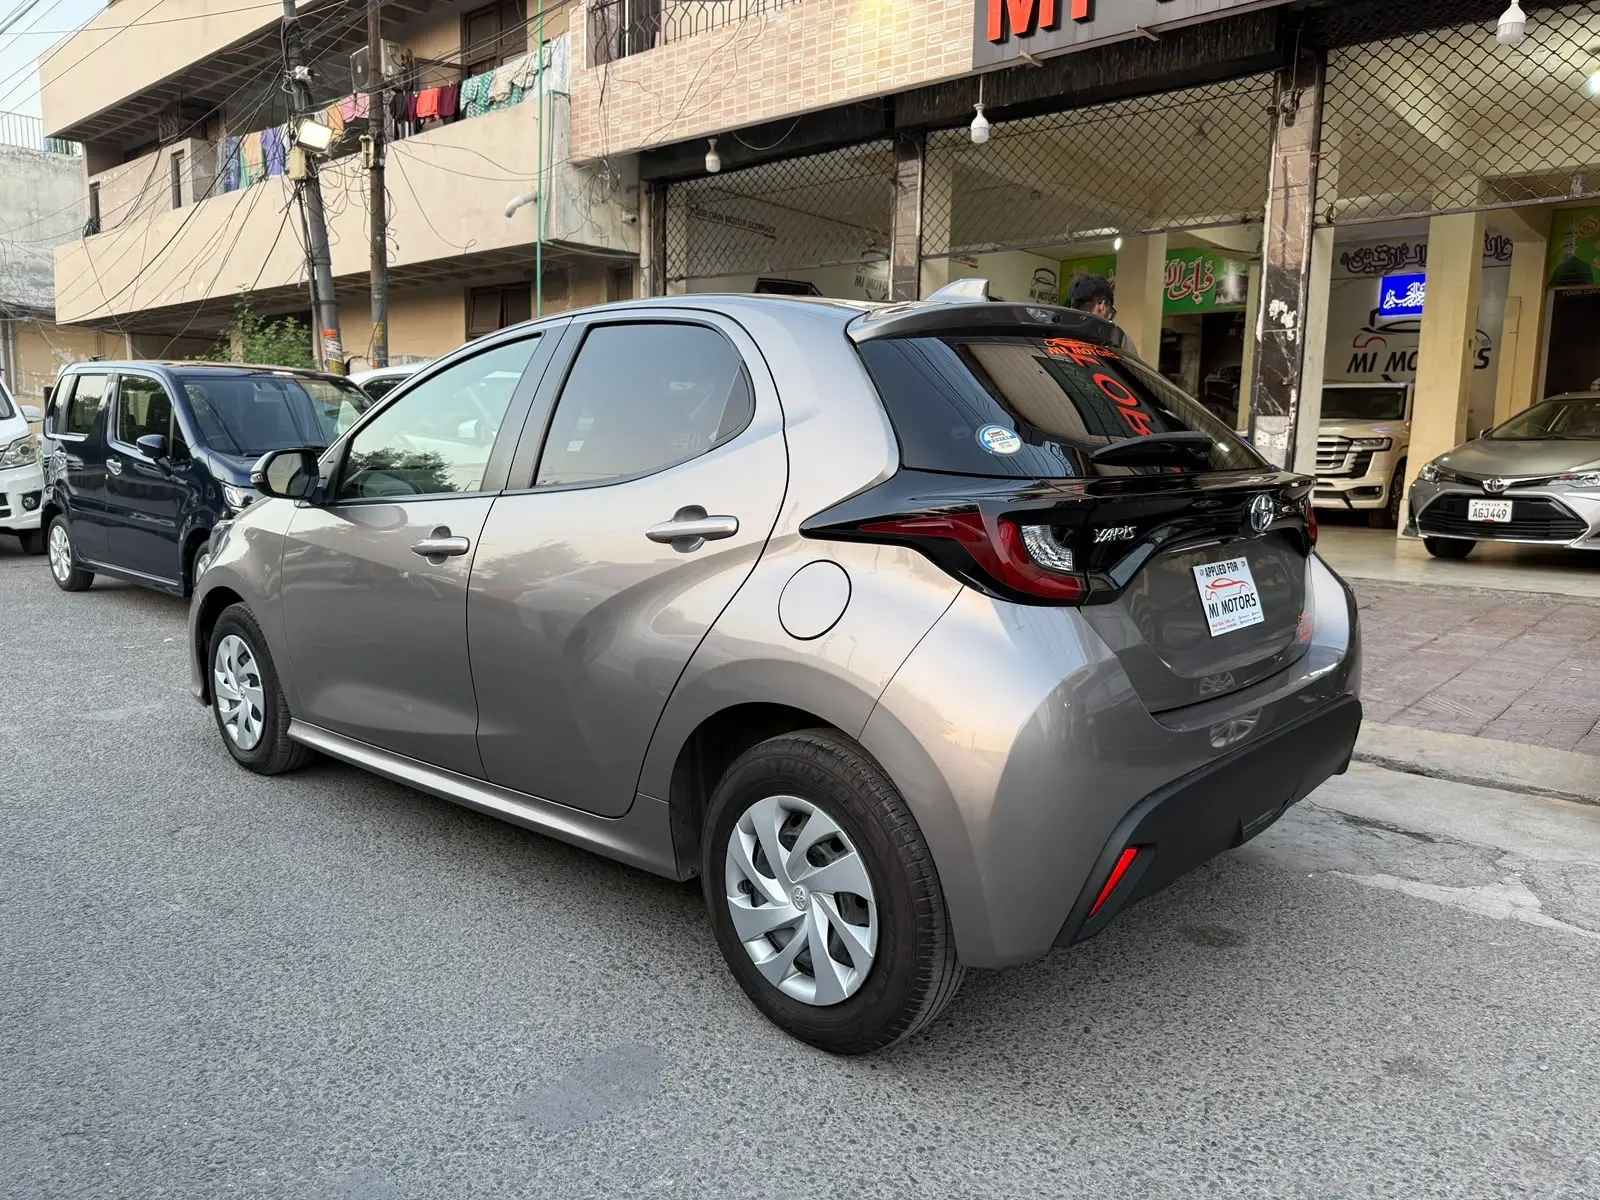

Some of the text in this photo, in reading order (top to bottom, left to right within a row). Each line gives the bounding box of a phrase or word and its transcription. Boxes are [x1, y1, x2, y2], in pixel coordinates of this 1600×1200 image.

[1347, 351, 1377, 374] MI
[1472, 508, 1507, 519] AGJ449
[1093, 525, 1138, 544] YARIS
[1204, 561, 1240, 579] APPLIED FOR
[1208, 602, 1220, 619] MI
[1221, 592, 1257, 616] MOTORS
